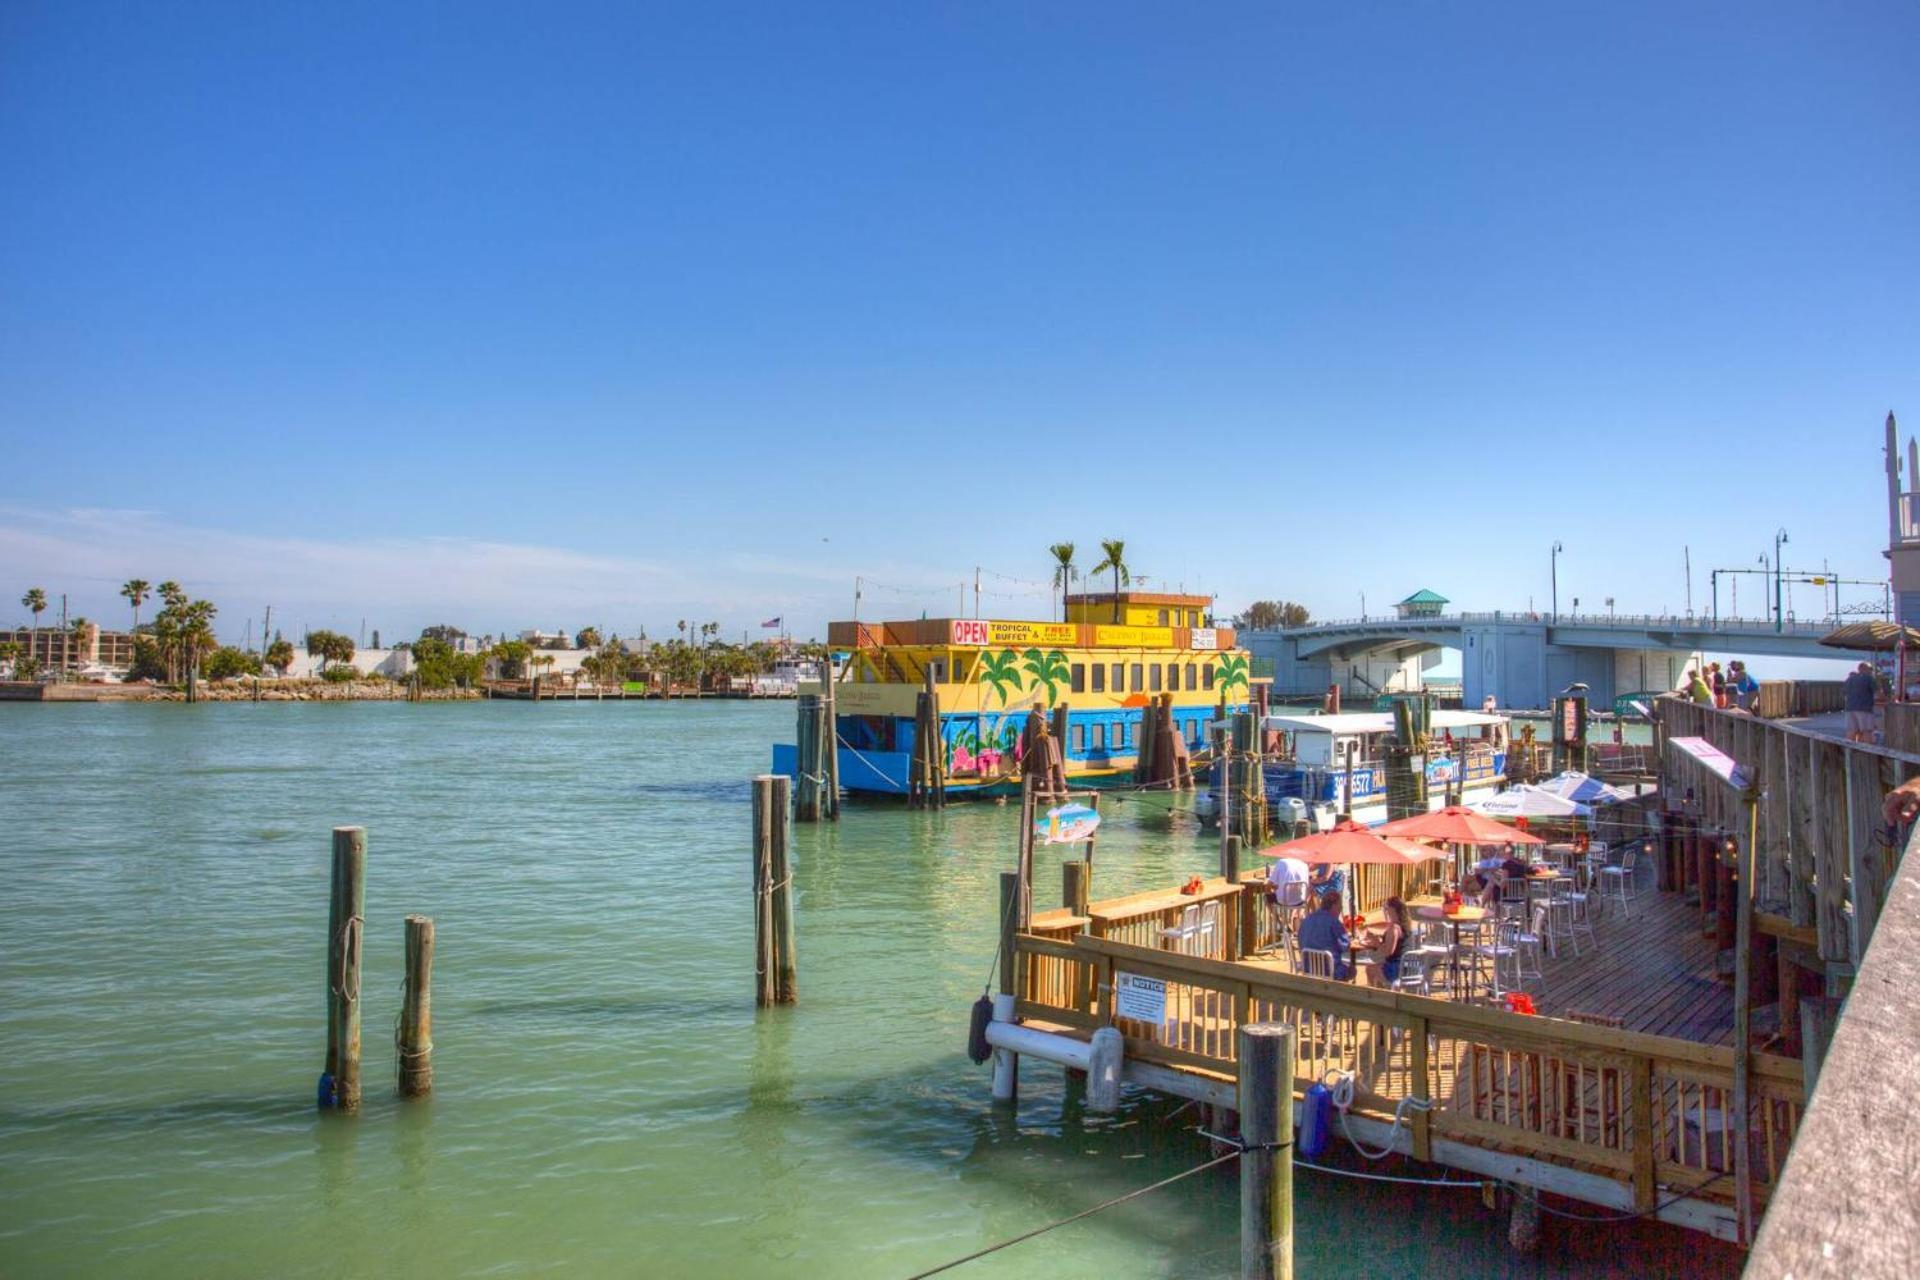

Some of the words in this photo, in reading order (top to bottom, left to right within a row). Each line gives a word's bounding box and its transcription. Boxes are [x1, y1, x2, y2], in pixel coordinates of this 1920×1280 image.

[955, 621, 988, 644] OPEN
[991, 624, 1032, 632] TROPICAL
[995, 633, 1027, 641] BUFFET
[1352, 772, 1370, 794] 6577
[1133, 978, 1166, 992] NOTICE
